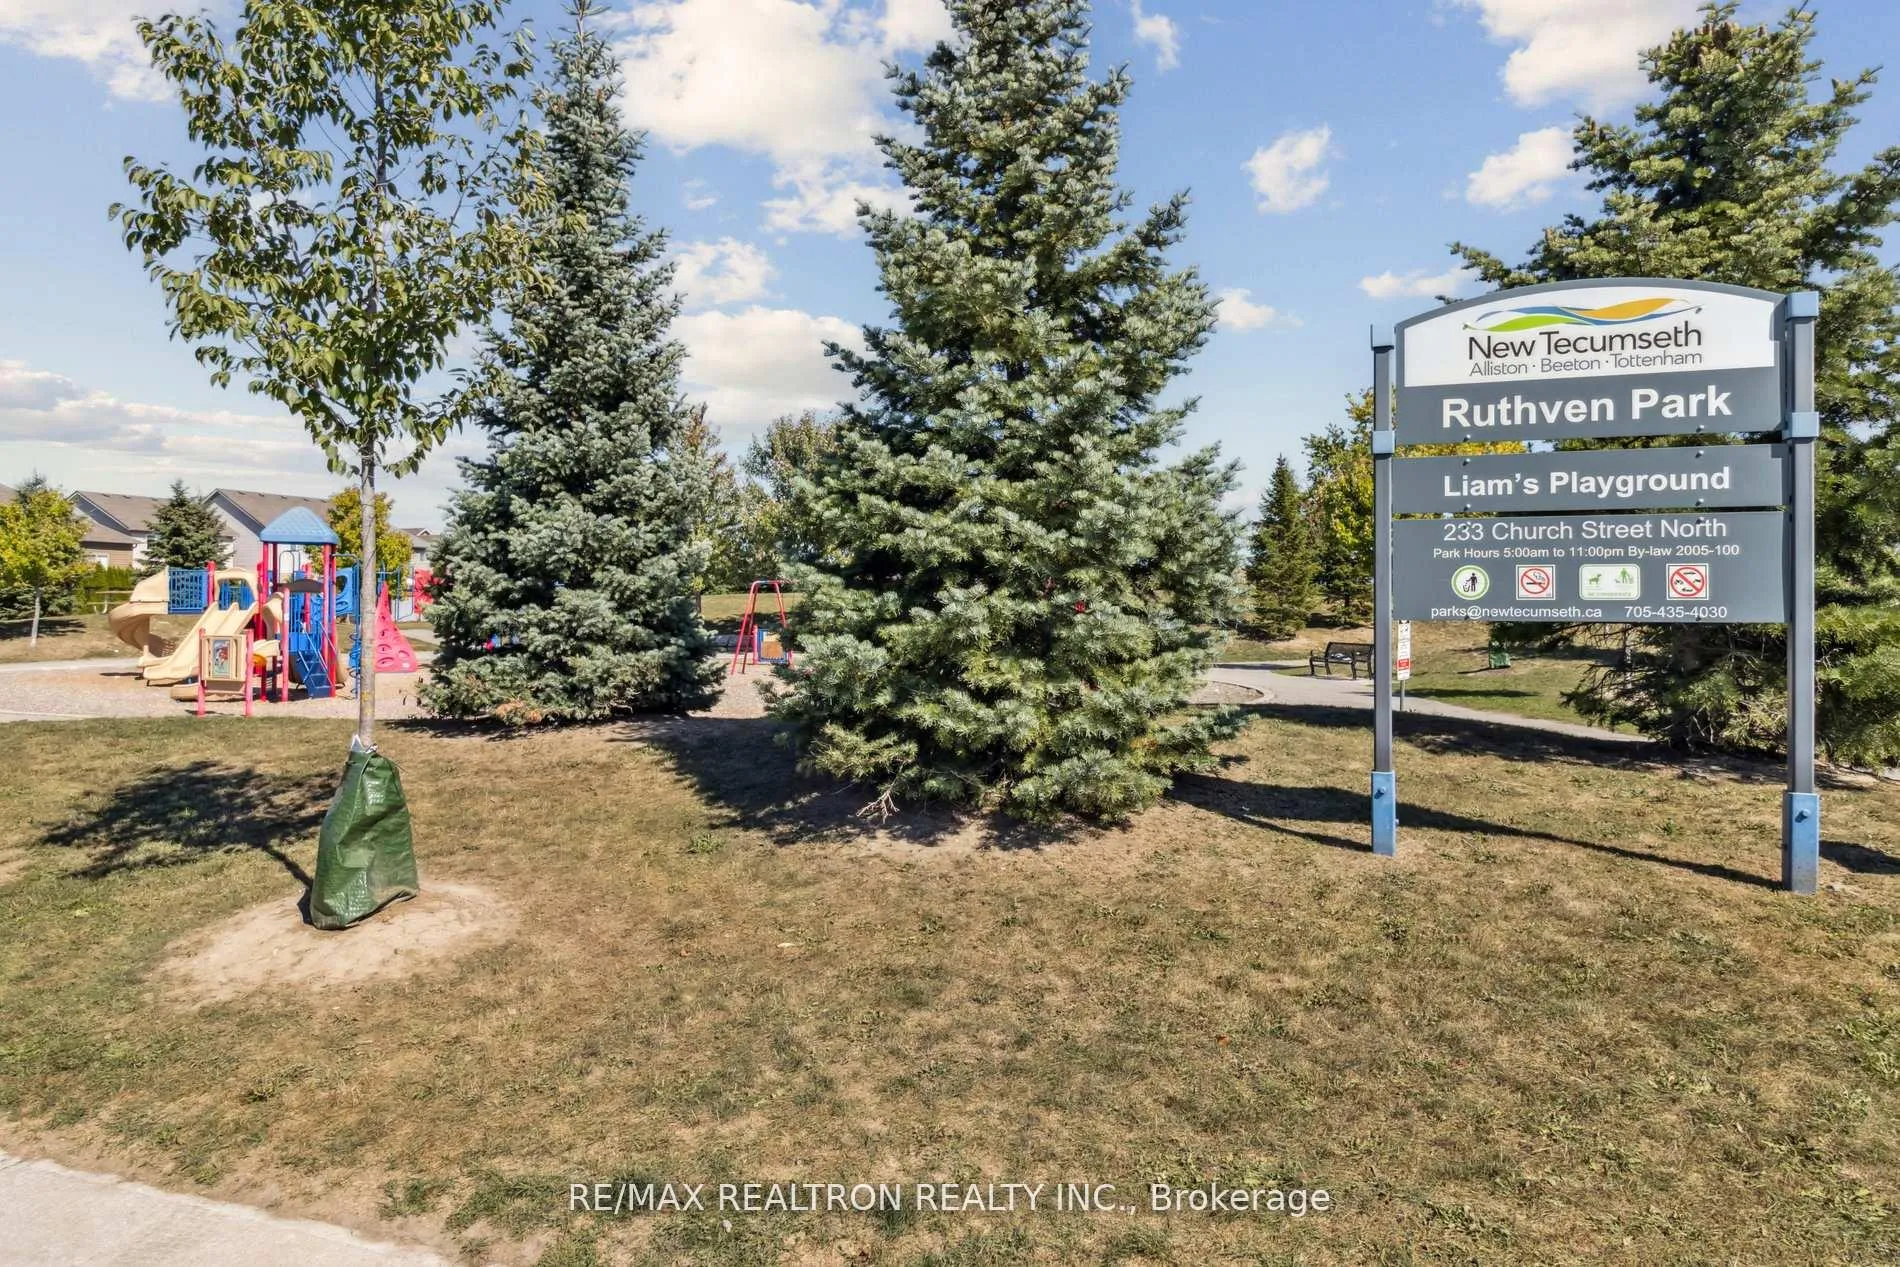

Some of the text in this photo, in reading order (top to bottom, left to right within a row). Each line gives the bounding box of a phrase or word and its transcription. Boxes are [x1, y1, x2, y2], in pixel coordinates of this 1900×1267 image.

[1469, 321, 1702, 360] New Tecumseth
[1469, 351, 1702, 377] Alliston Beeton Tottenham
[1442, 385, 1733, 428] Ruthven Park
[1444, 466, 1730, 499] Liam's Playground
[1444, 518, 1727, 542] 233 Church Street North
[1433, 544, 1739, 560] Park Hours 5:00am to 11:00pm By-law 2005-100
[1431, 606, 1727, 621] parks@newtecumseth.ca 705-435-4030
